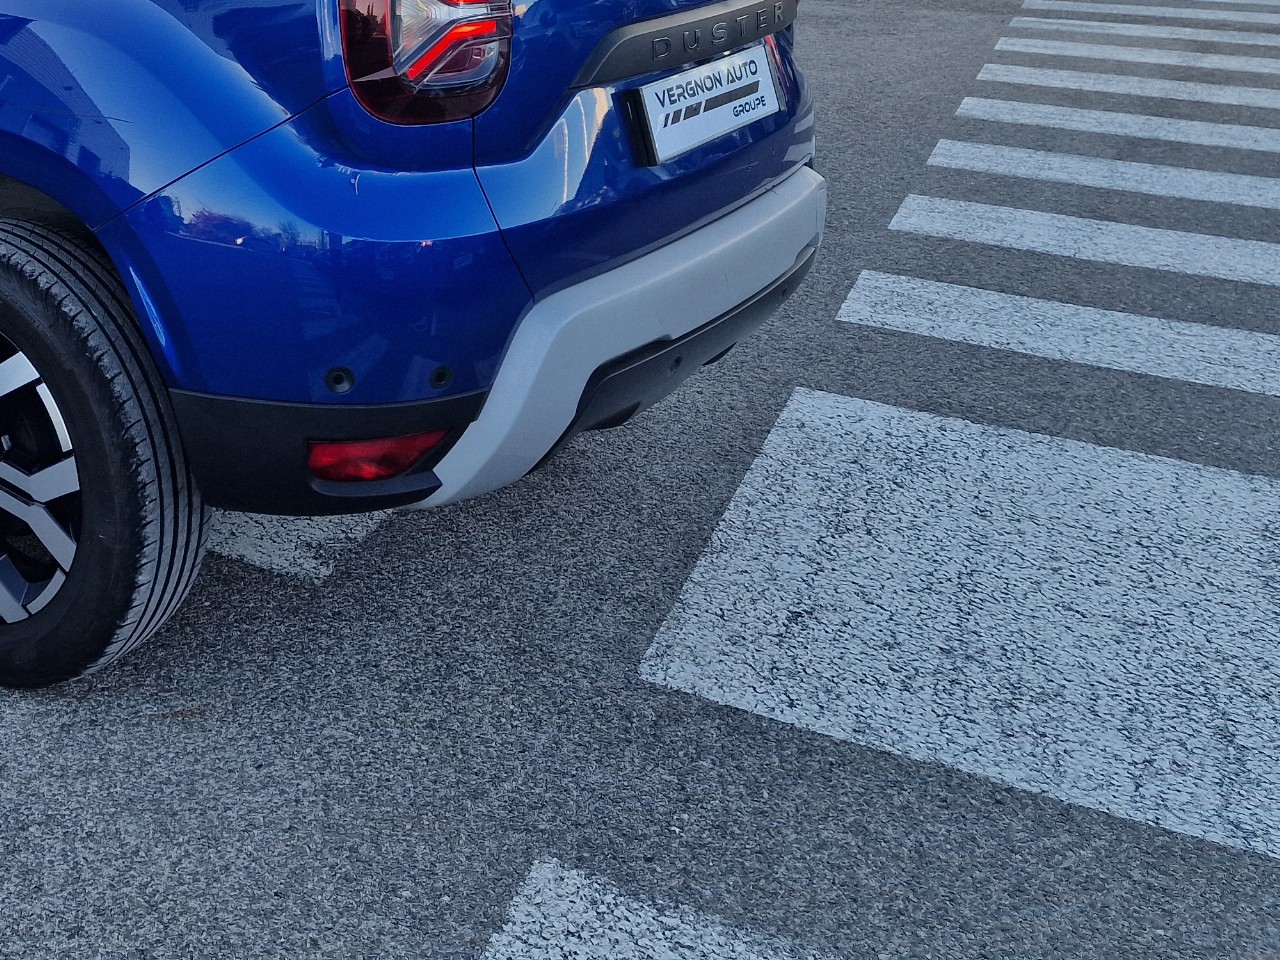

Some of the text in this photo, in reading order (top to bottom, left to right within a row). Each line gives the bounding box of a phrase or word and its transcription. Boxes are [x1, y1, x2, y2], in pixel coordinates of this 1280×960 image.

[652, 1, 784, 61] DUSTER
[654, 59, 758, 108] VERGNON AUTO
[732, 95, 767, 117] GROUPE
